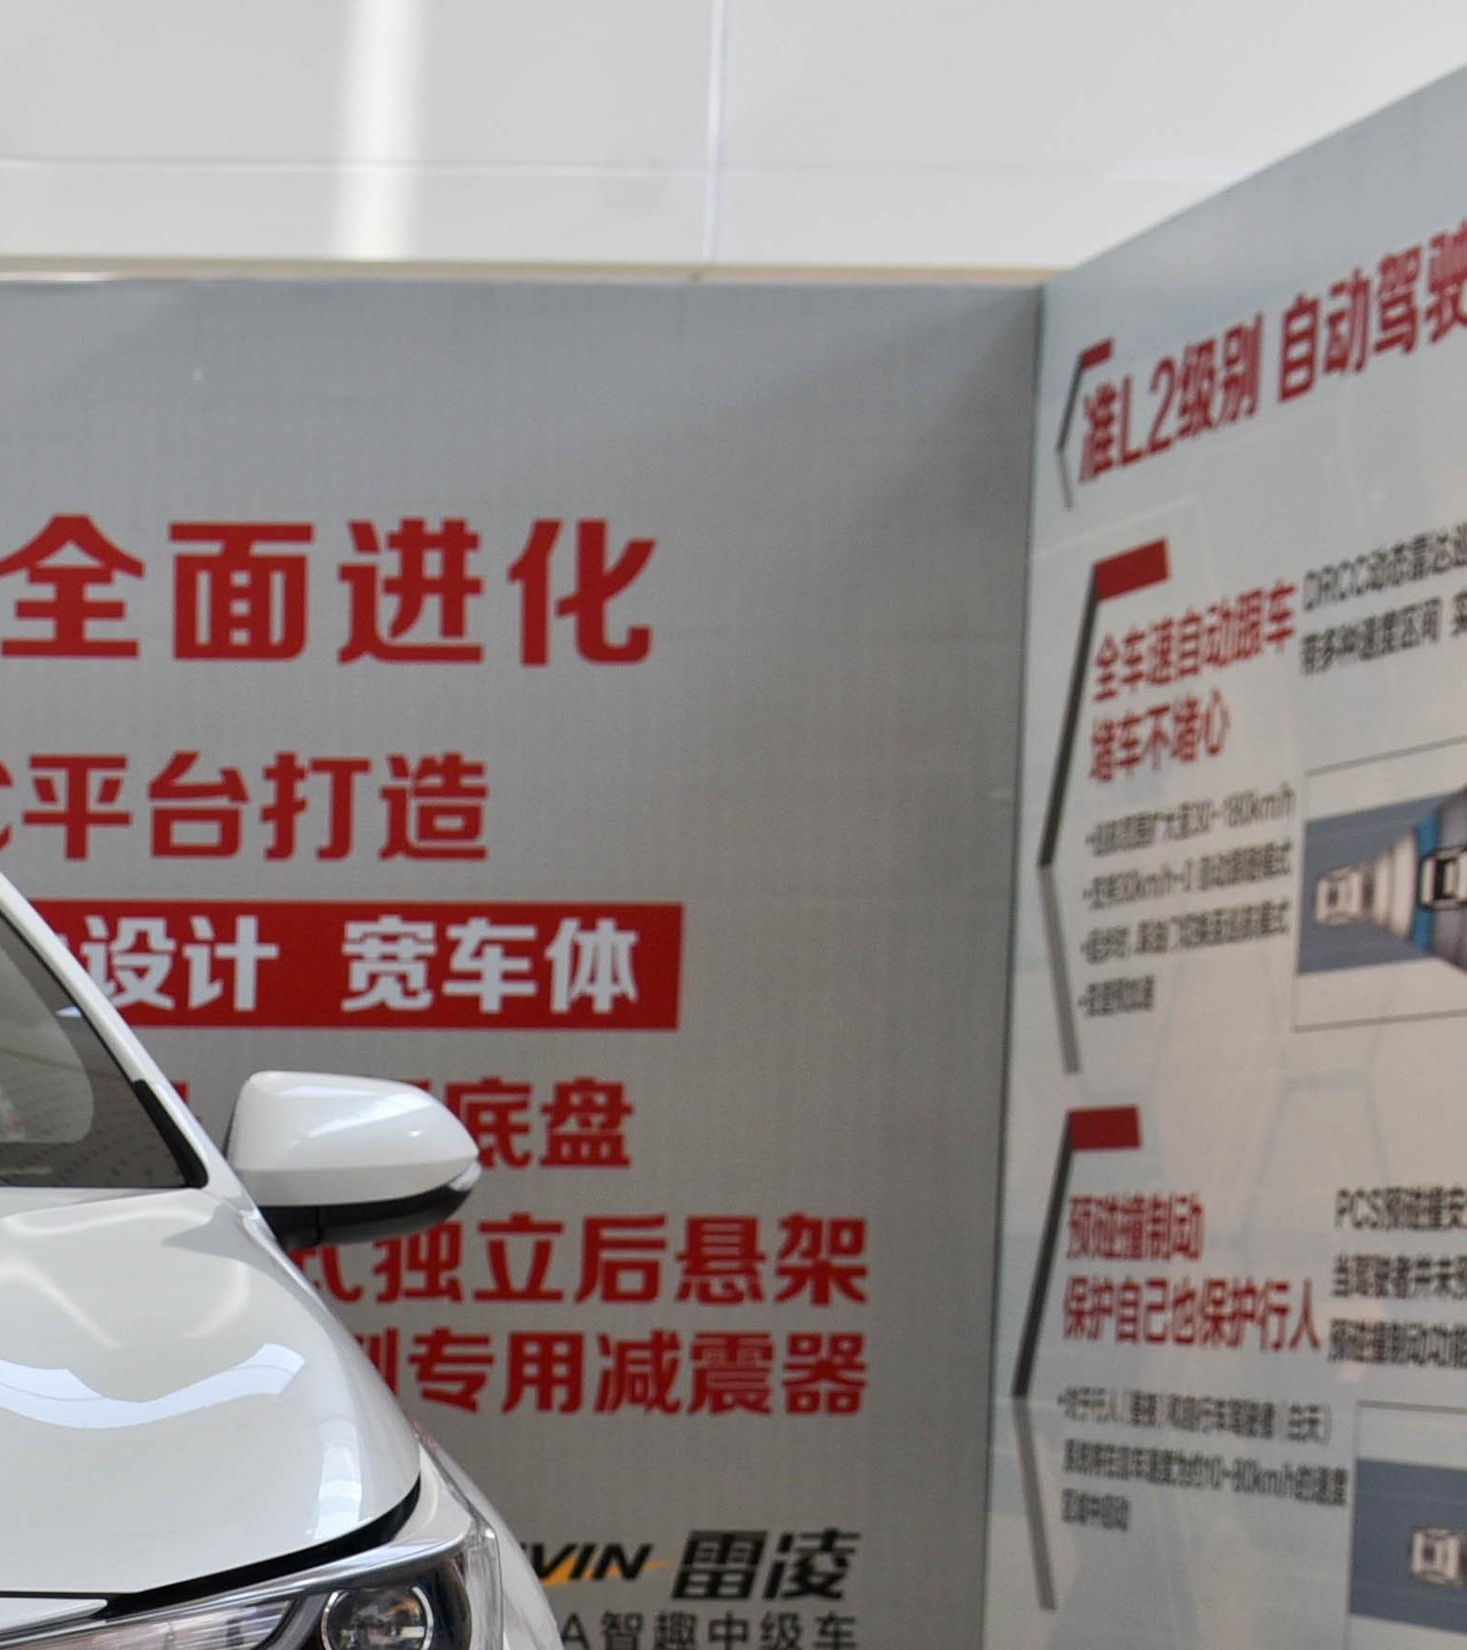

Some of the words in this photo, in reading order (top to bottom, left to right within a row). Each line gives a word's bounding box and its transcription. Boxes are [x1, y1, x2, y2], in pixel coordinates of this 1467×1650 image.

[80, 914, 279, 1013] 设计
[341, 914, 641, 1015] 宽车体
[402, 1078, 633, 1169] 底盘
[522, 1542, 655, 1581] VIN
[671, 1529, 862, 1601] 雷凌
